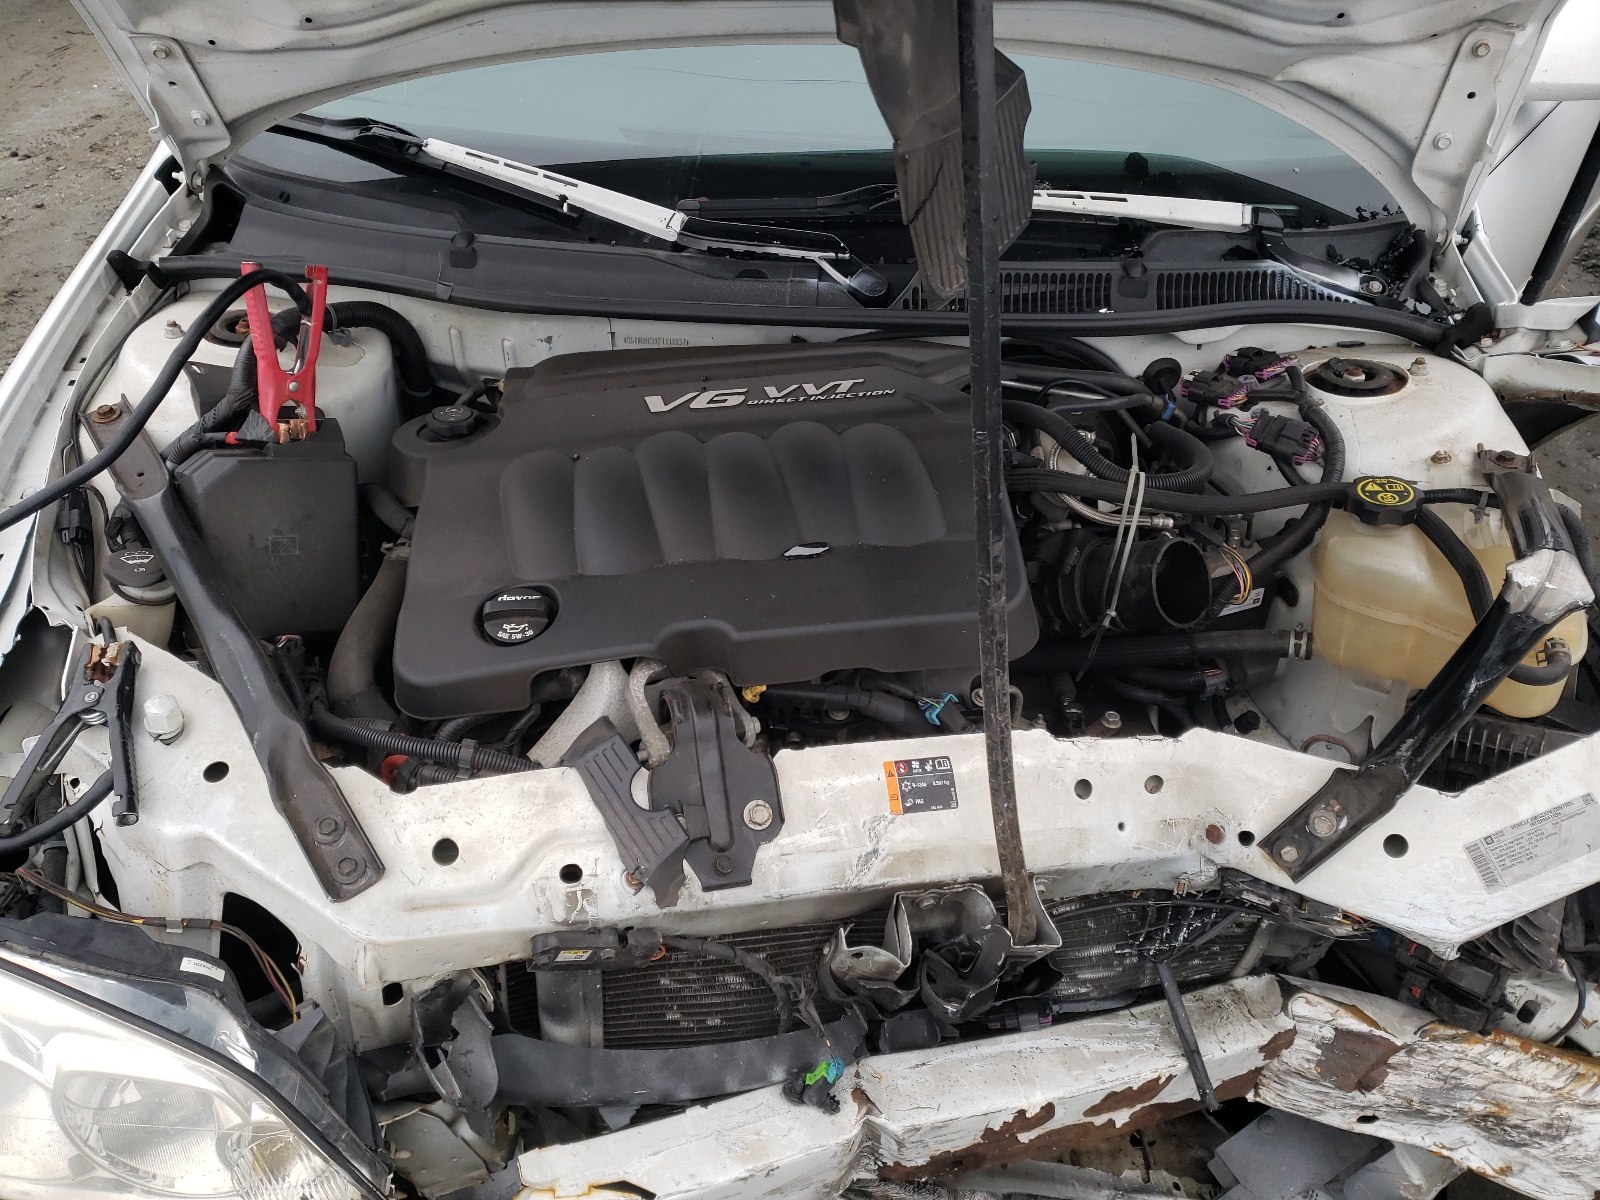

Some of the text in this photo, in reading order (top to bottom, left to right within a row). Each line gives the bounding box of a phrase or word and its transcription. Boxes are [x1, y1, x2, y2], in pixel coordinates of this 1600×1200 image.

[644, 378, 865, 412] V6 VVT
[747, 388, 896, 405] DIRECT INJECTION
[497, 629, 534, 640] SAE 5W-30
[1552, 801, 1574, 812] CONTROL
